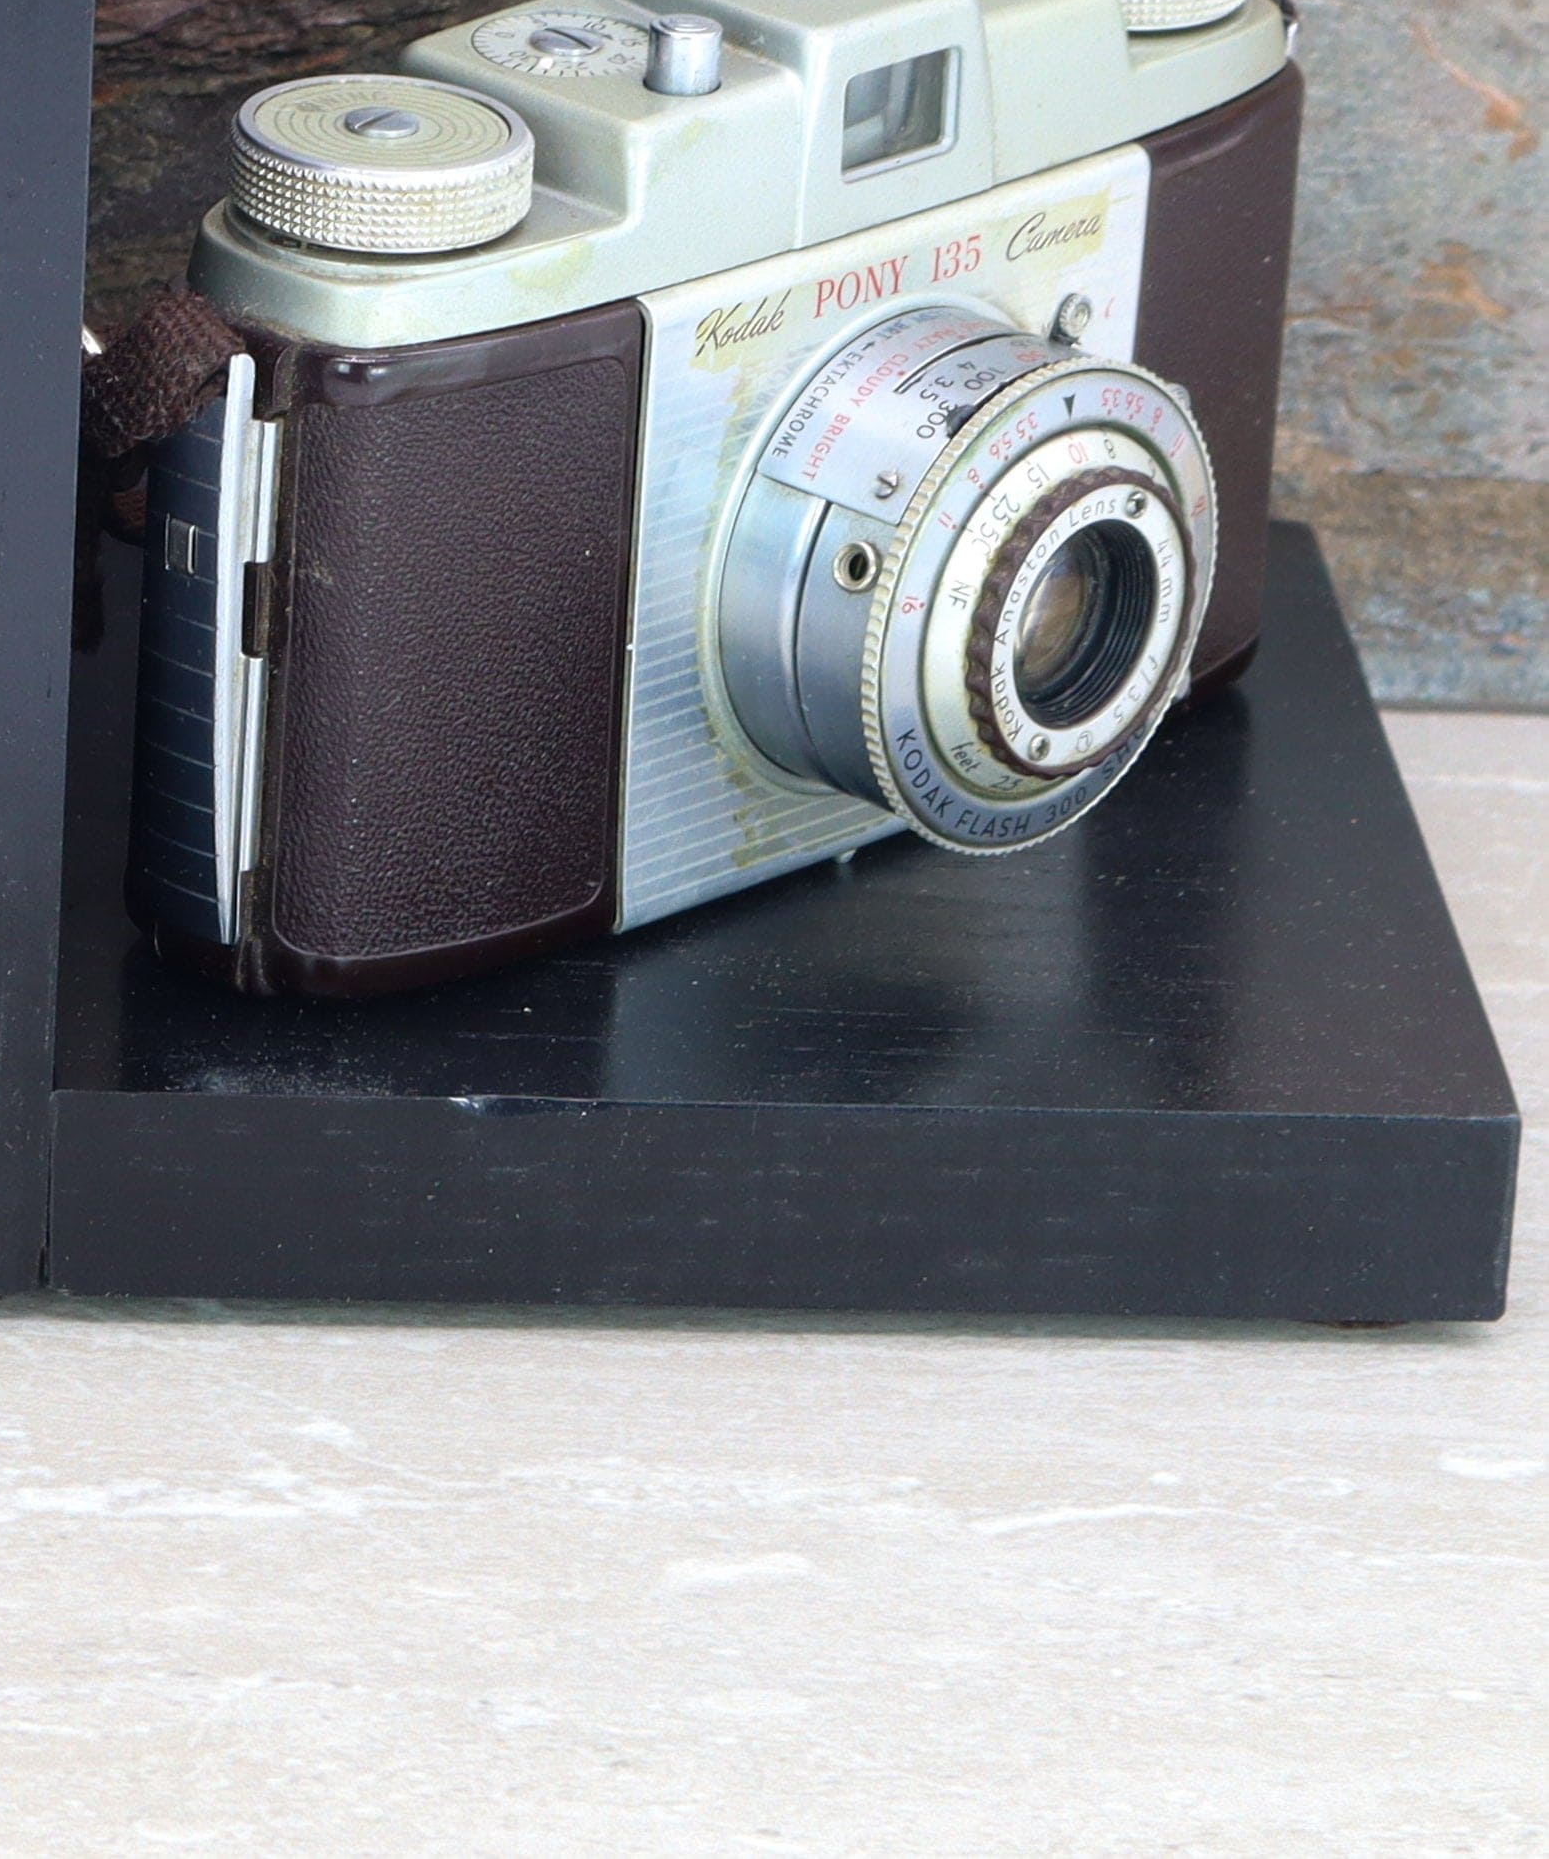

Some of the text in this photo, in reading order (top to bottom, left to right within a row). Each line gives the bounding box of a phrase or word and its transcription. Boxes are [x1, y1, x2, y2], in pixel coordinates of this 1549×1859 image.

[695, 211, 1104, 358] Kodak PONY 135 Camera
[771, 349, 864, 459] EKTACHROME
[849, 352, 909, 409] CLOUDY
[801, 412, 851, 482] BRIGHT
[915, 400, 958, 440] 300
[1069, 498, 1116, 528] Lens
[993, 528, 1061, 646] Anaston
[989, 664, 1025, 743] Kodak
[895, 728, 1088, 840] KODAK FLASH 300
[949, 741, 983, 774] feet
